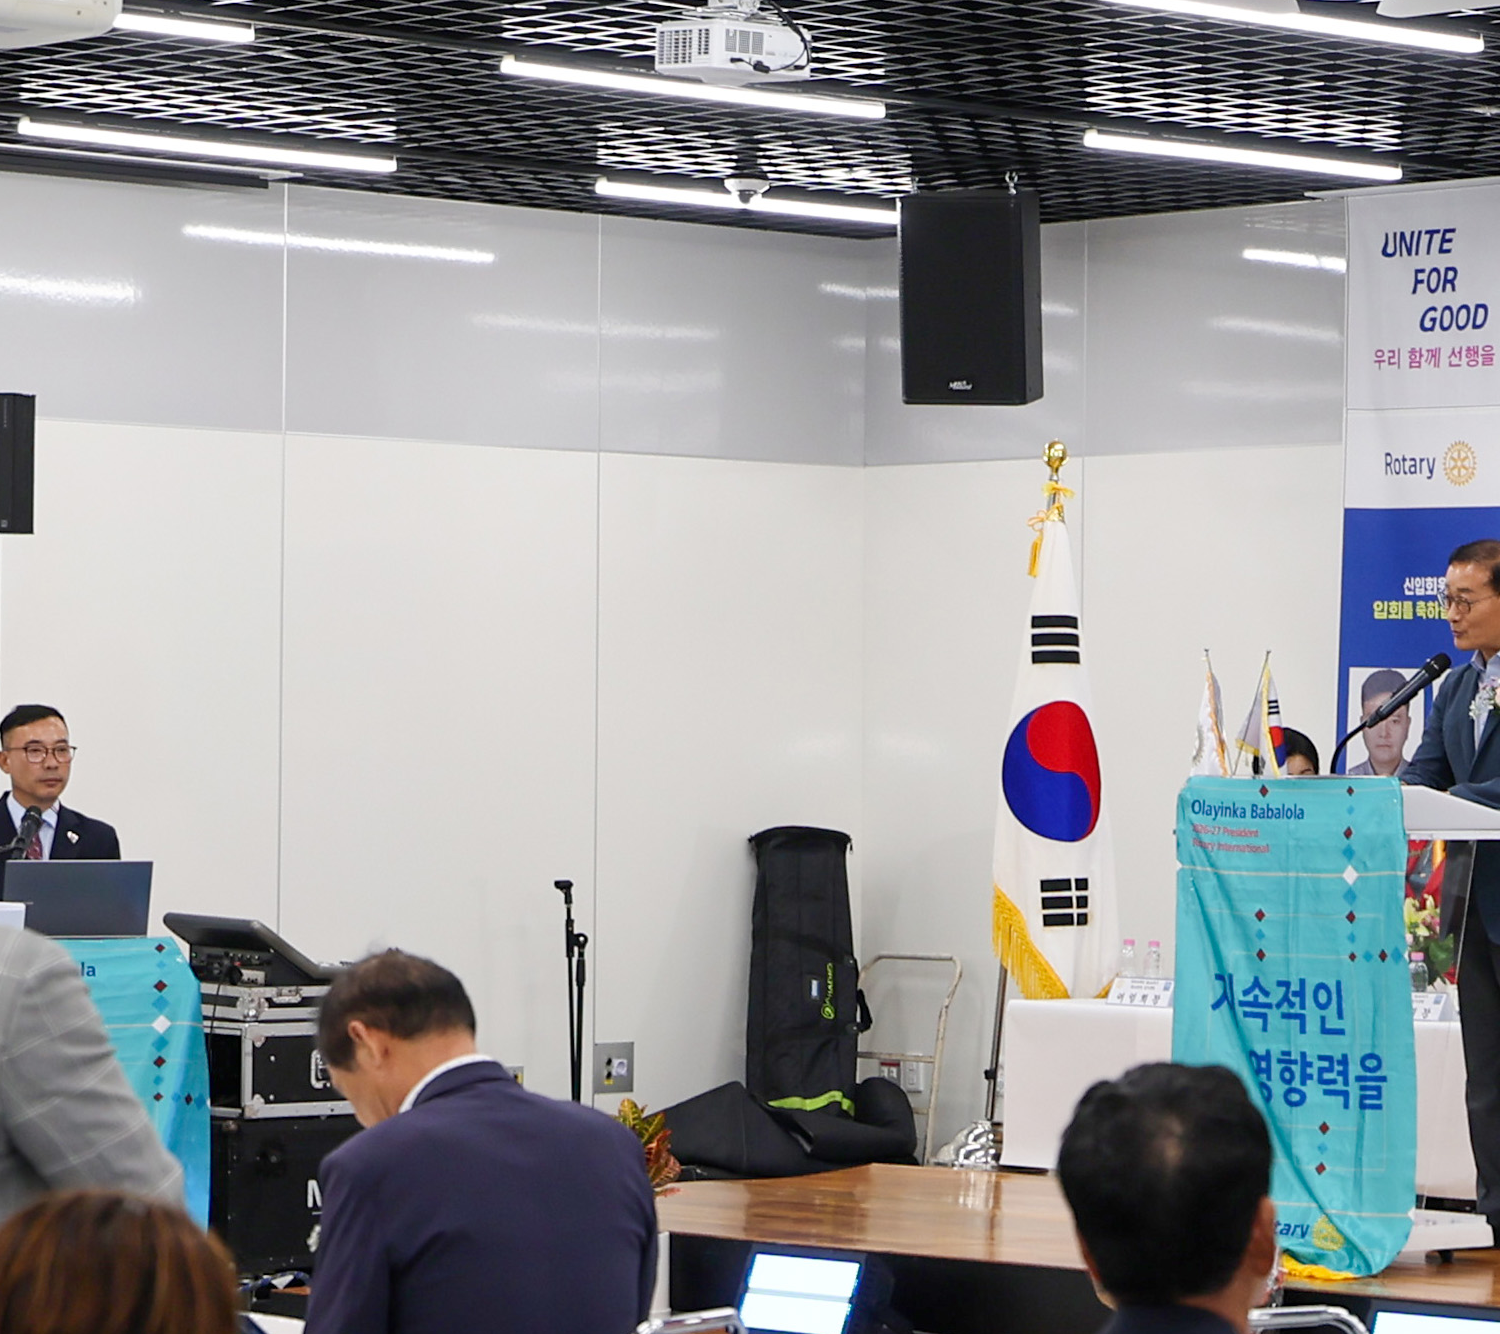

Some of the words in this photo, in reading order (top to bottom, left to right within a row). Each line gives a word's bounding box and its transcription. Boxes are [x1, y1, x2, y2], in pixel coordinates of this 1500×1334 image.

[1381, 227, 1457, 258] UNITE
[1411, 265, 1459, 295] FOR
[1419, 303, 1490, 332] GOOD
[1373, 347, 1402, 370] 우리
[1408, 346, 1442, 369] 함께
[1447, 344, 1496, 368] 선행을
[1384, 452, 1436, 480] Rotary
[1191, 798, 1247, 821] Olayinka
[1250, 802, 1305, 820] Babalola
[1274, 1219, 1311, 1239] tary
